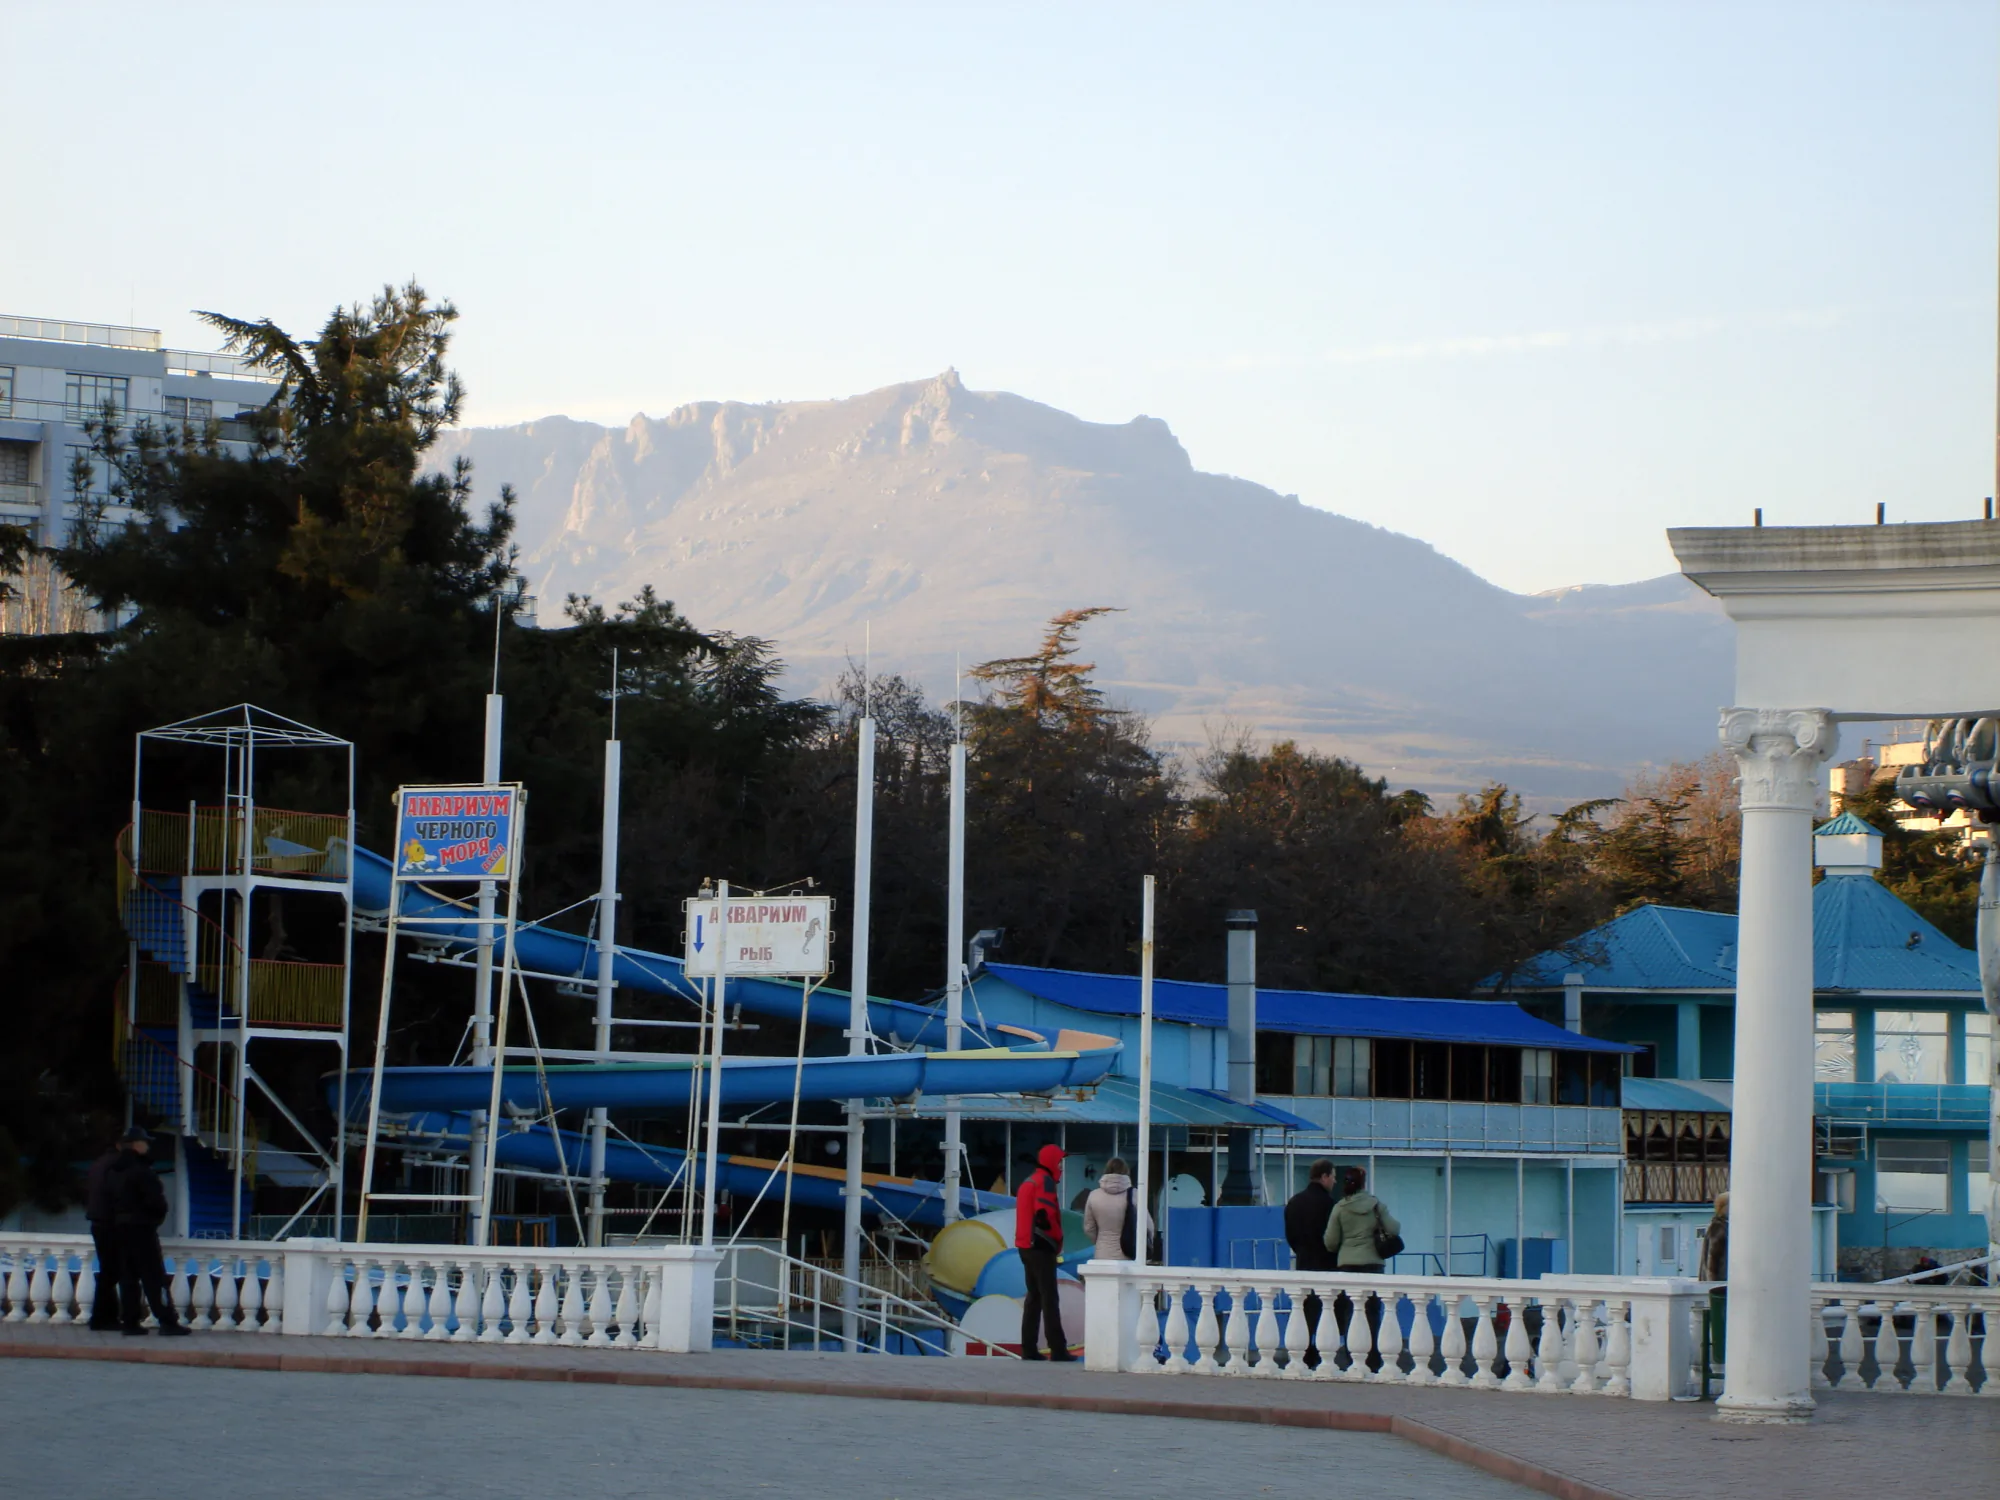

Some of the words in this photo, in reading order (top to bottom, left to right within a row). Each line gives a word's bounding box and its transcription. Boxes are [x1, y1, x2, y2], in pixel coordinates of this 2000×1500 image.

[406, 795, 510, 817] АКВАРИУМ
[415, 820, 497, 840] ЧЕРНОГО
[439, 837, 490, 866] МОРЯ
[739, 946, 773, 961] РЫБ
